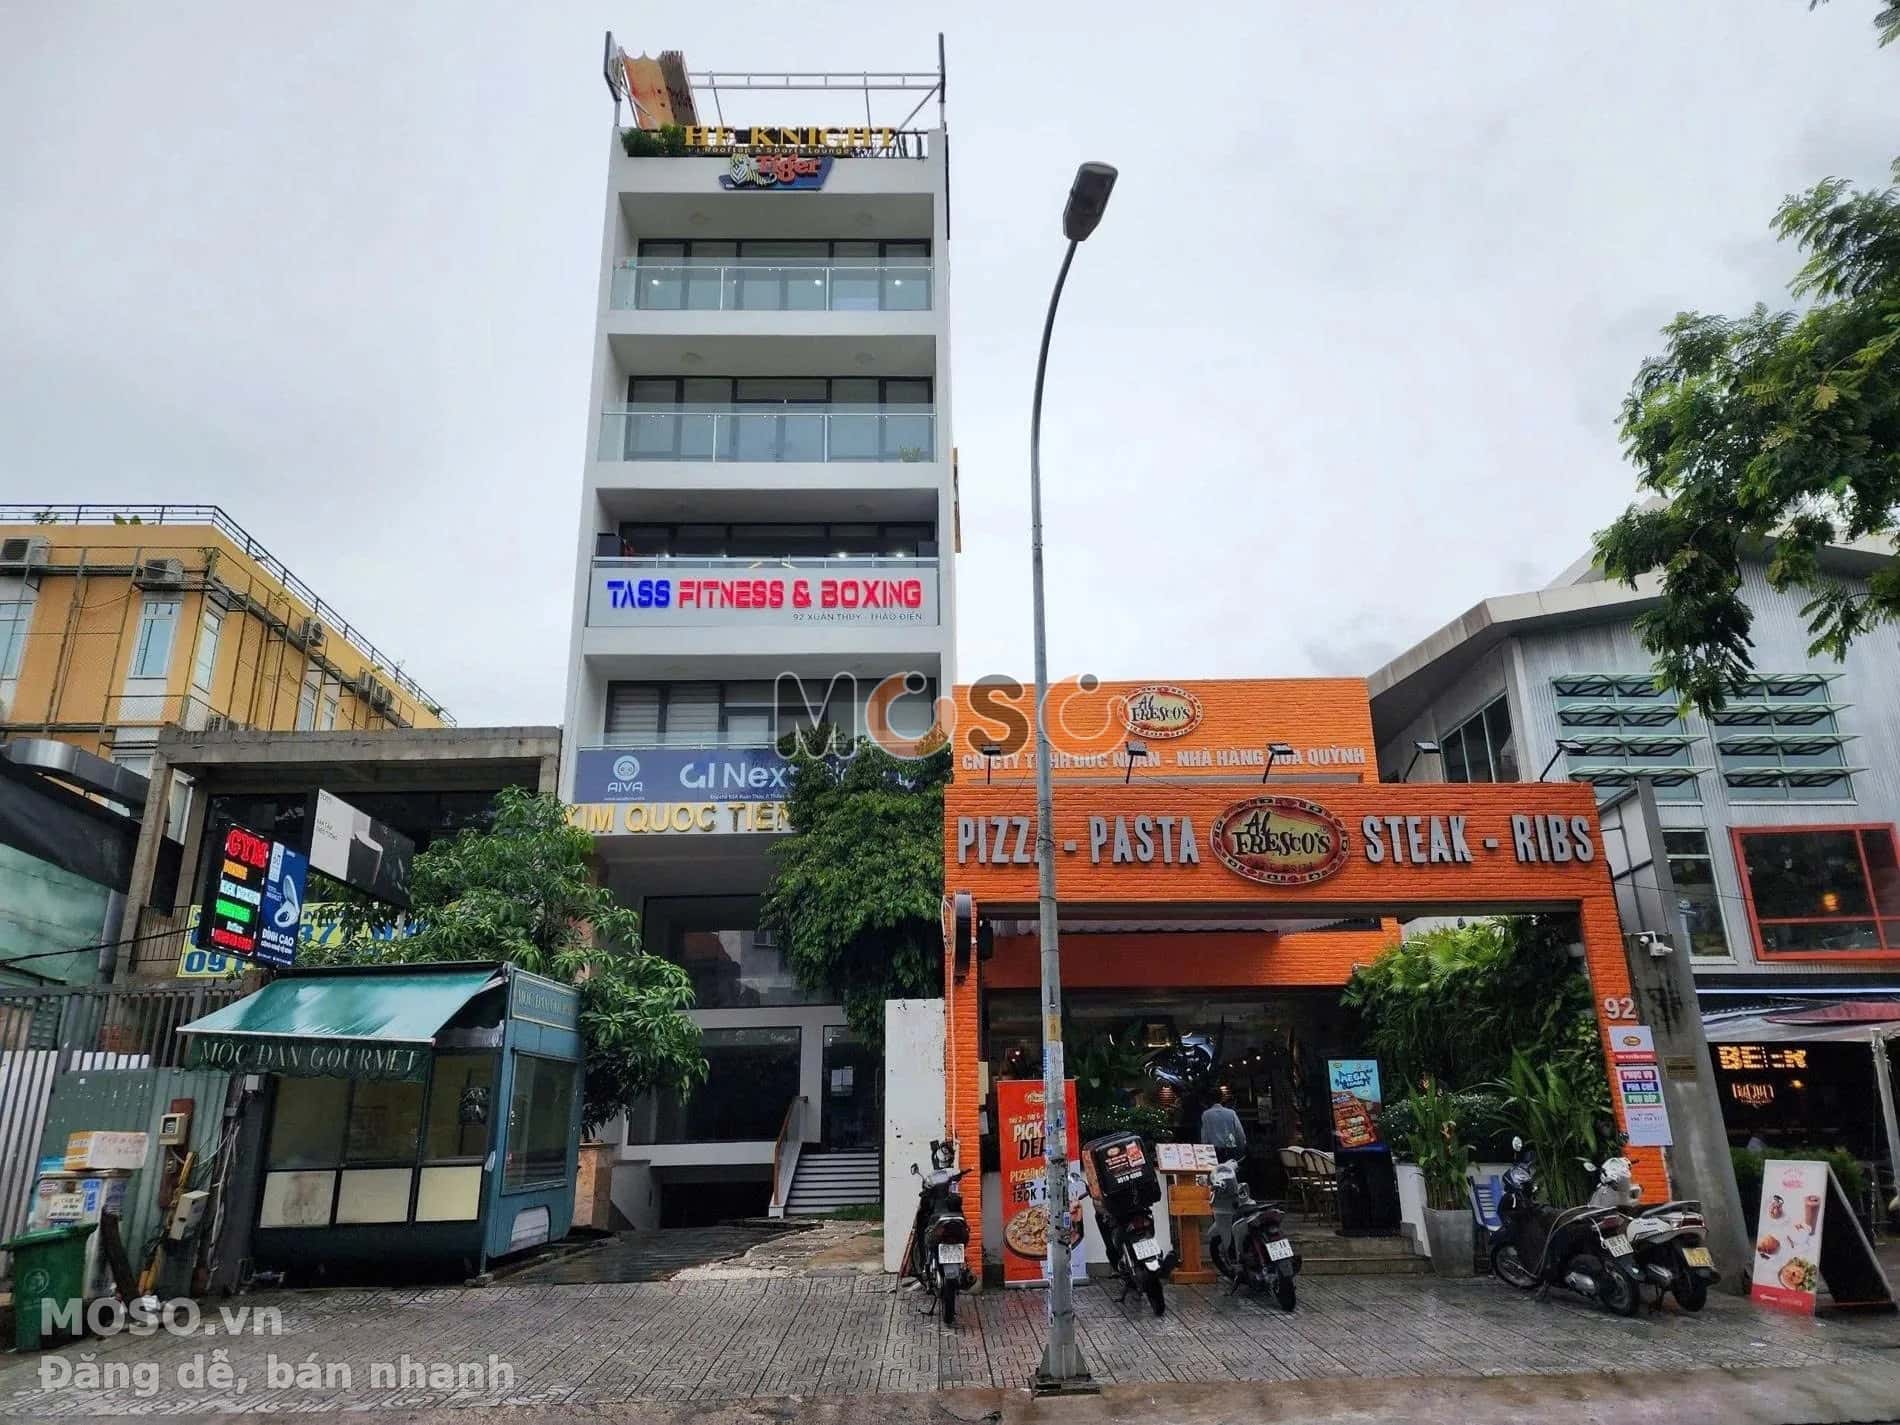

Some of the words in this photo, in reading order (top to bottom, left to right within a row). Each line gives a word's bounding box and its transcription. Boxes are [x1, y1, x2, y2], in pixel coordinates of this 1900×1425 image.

[750, 126, 896, 146] KNIGHT
[755, 154, 821, 183] Tiger
[607, 579, 671, 609] TASS
[678, 580, 785, 609] FITNESS
[793, 580, 812, 609] &
[820, 580, 922, 609] BOXING
[962, 753, 984, 770] CN
[1025, 753, 1070, 769] THH
[608, 782, 643, 793] AIVA
[227, 829, 269, 869] GYM
[958, 815, 1041, 864] PIZZ
[1090, 815, 1201, 864] PASTA
[1361, 814, 1474, 863] STEAK
[1512, 814, 1595, 863] RIBS
[1604, 997, 1636, 1020] 92
[310, 1045, 421, 1071] GOURMET
[1013, 1120, 1043, 1143] PICK
